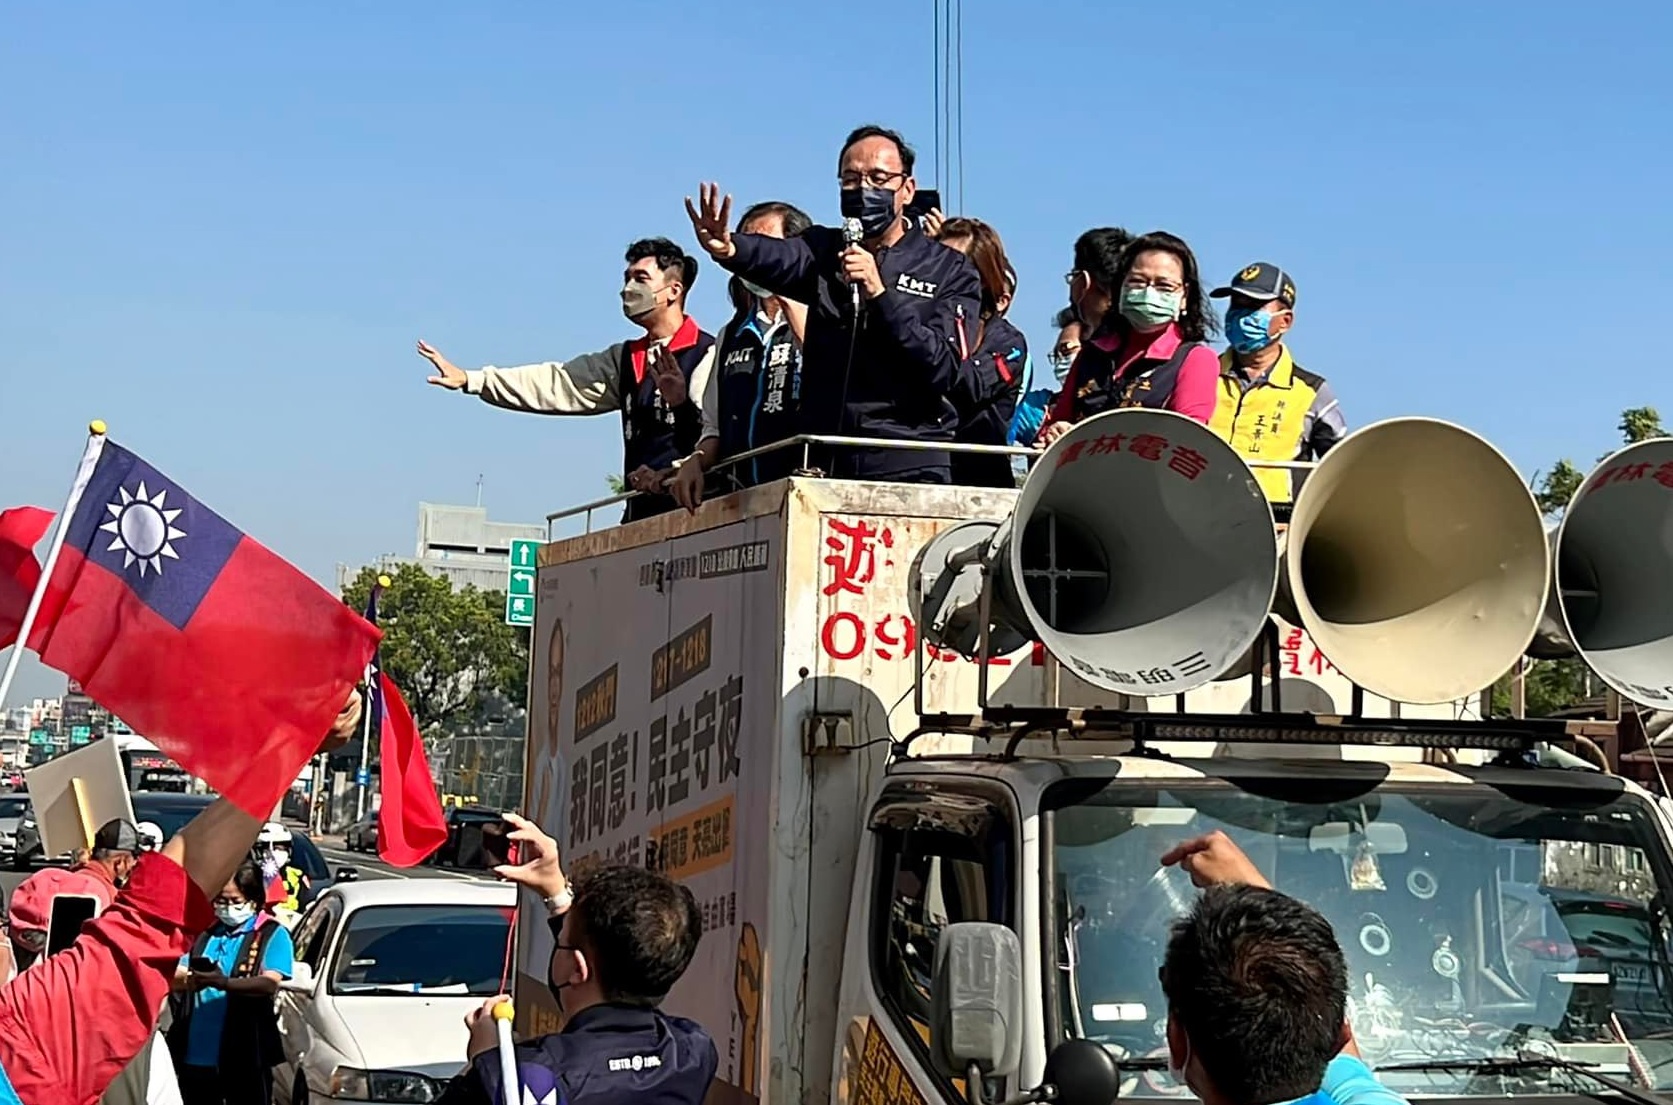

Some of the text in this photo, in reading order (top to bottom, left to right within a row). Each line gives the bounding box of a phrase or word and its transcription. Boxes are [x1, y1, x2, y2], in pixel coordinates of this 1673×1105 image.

[898, 272, 937, 292] KMT
[763, 342, 792, 414] 蘇清泉
